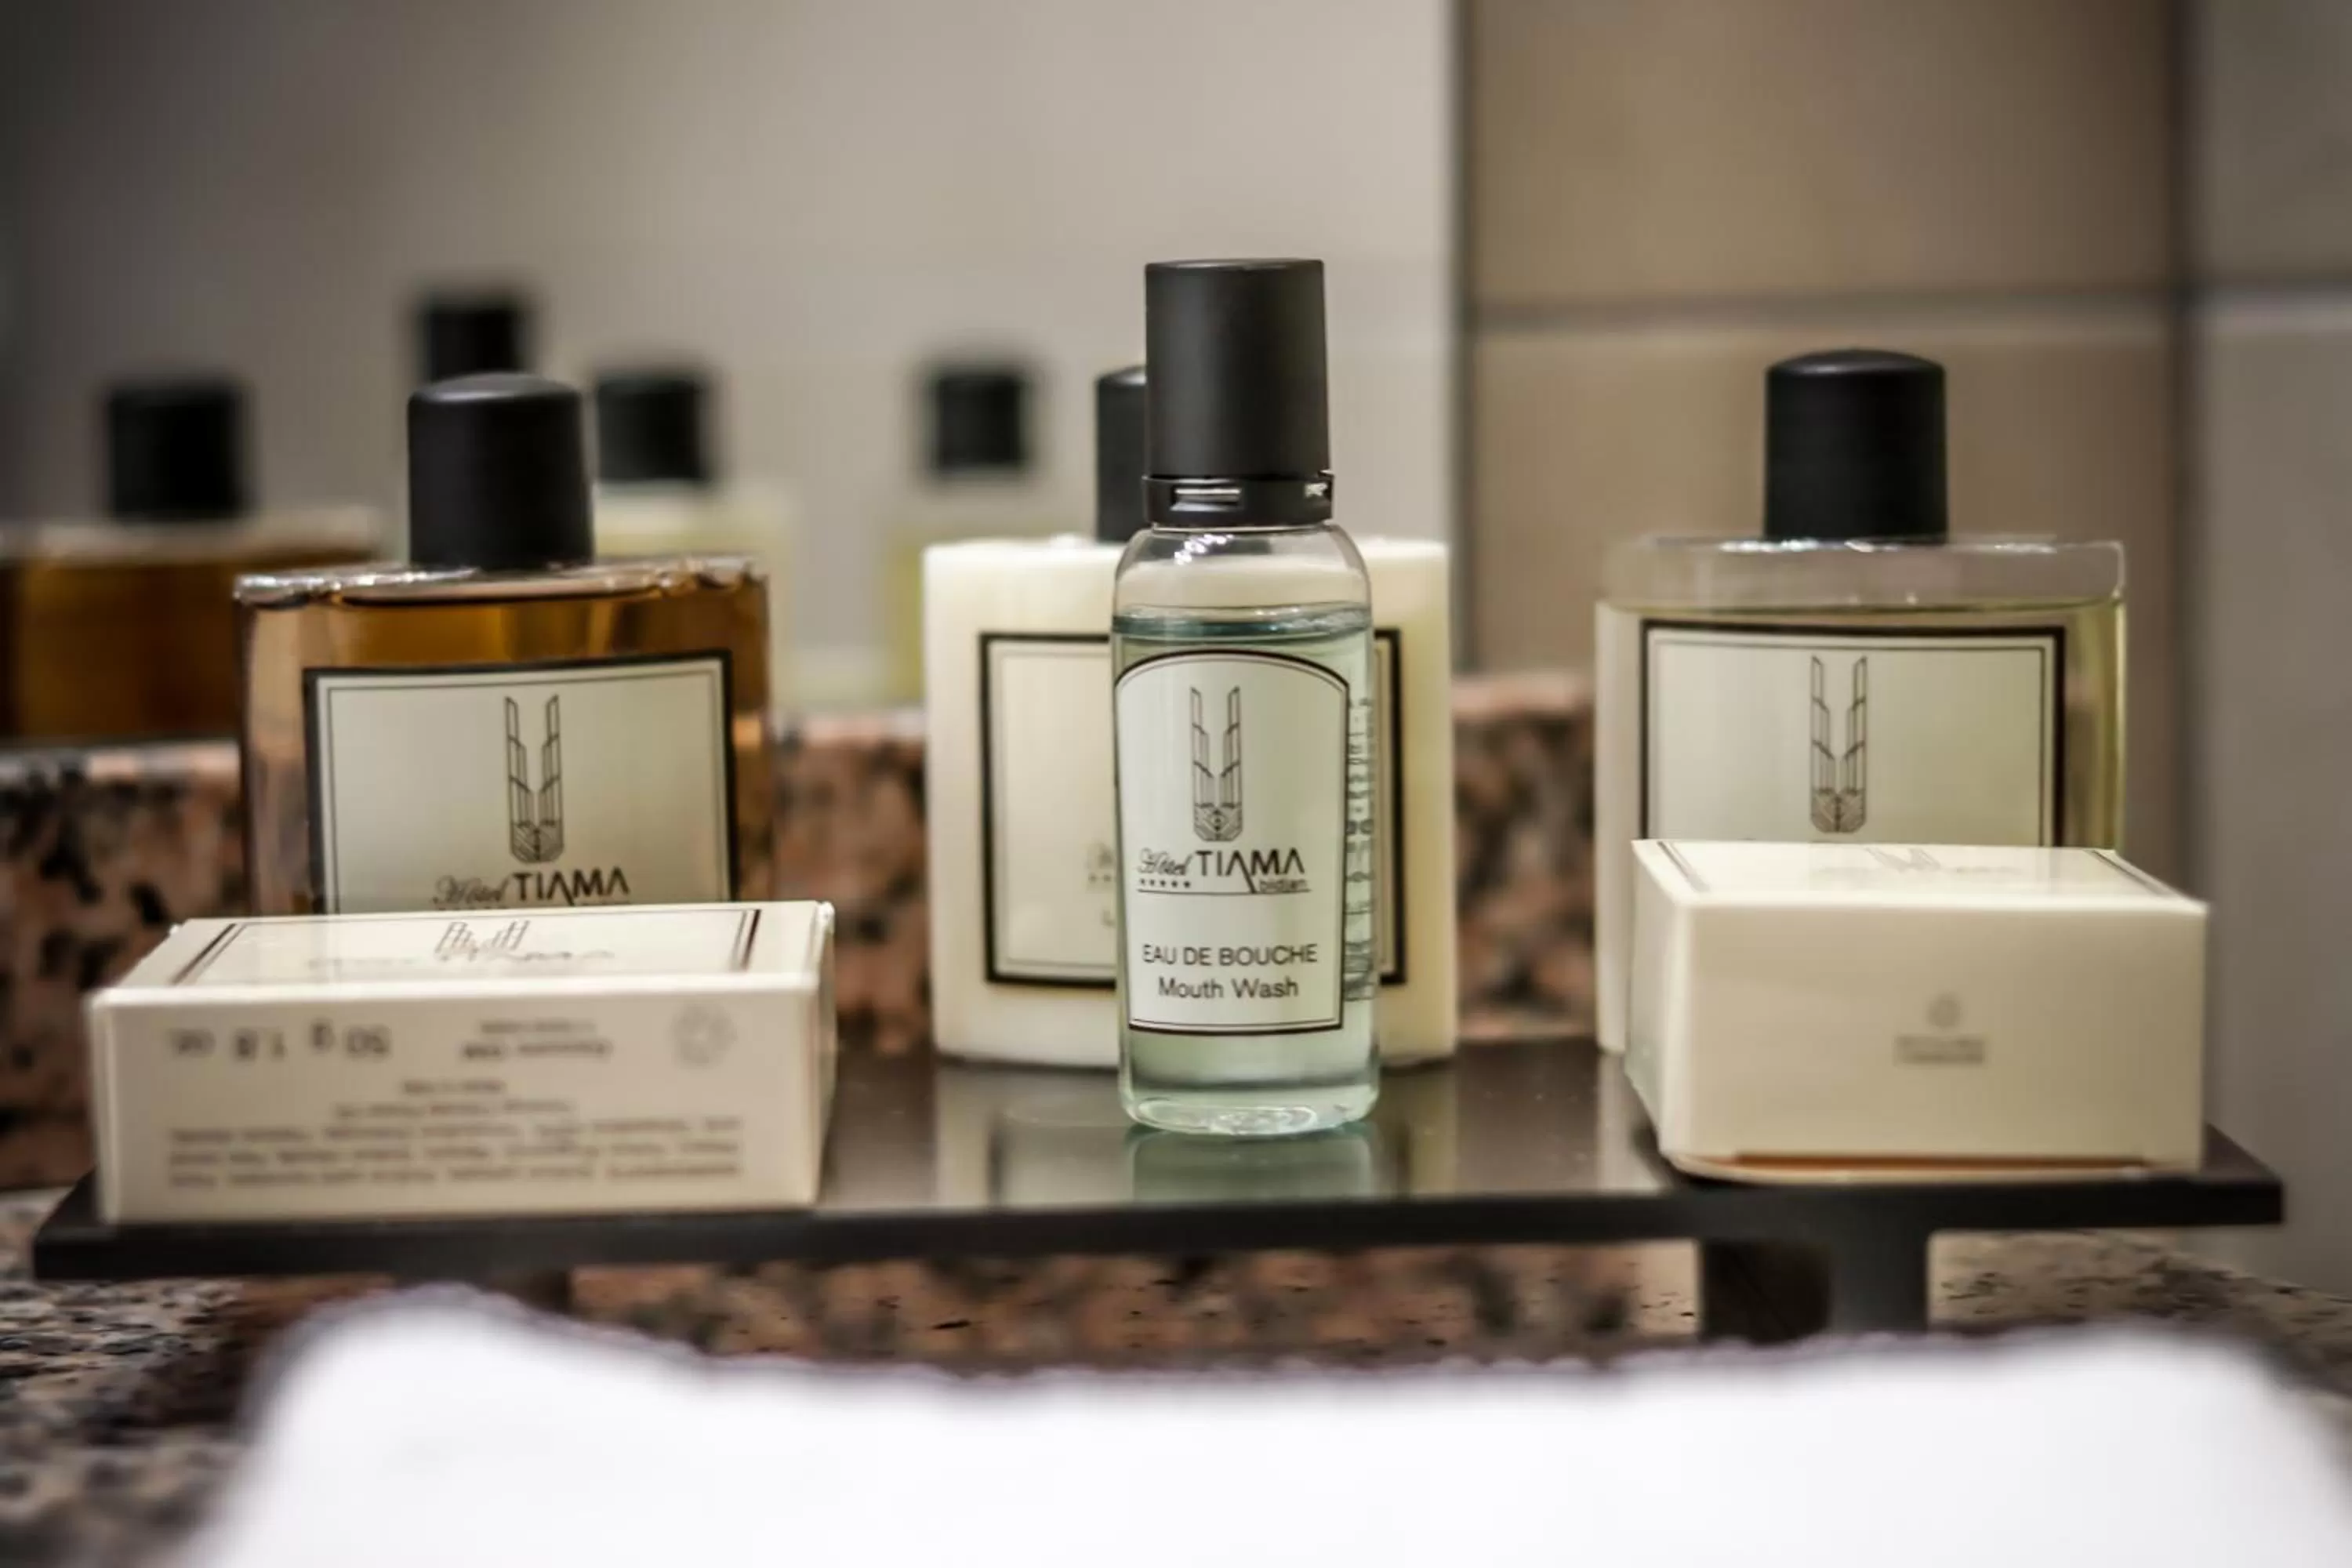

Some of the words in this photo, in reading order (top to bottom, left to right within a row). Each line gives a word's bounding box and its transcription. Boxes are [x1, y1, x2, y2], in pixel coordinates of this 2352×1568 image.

[512, 866, 630, 906] TIAMA
[1196, 847, 1305, 894] TIAMA
[1142, 943, 1177, 965] EAU
[1182, 946, 1214, 967] DE
[1218, 943, 1319, 967] BOUCHE
[1157, 976, 1225, 999] Mouth
[1230, 975, 1299, 999] Wash
